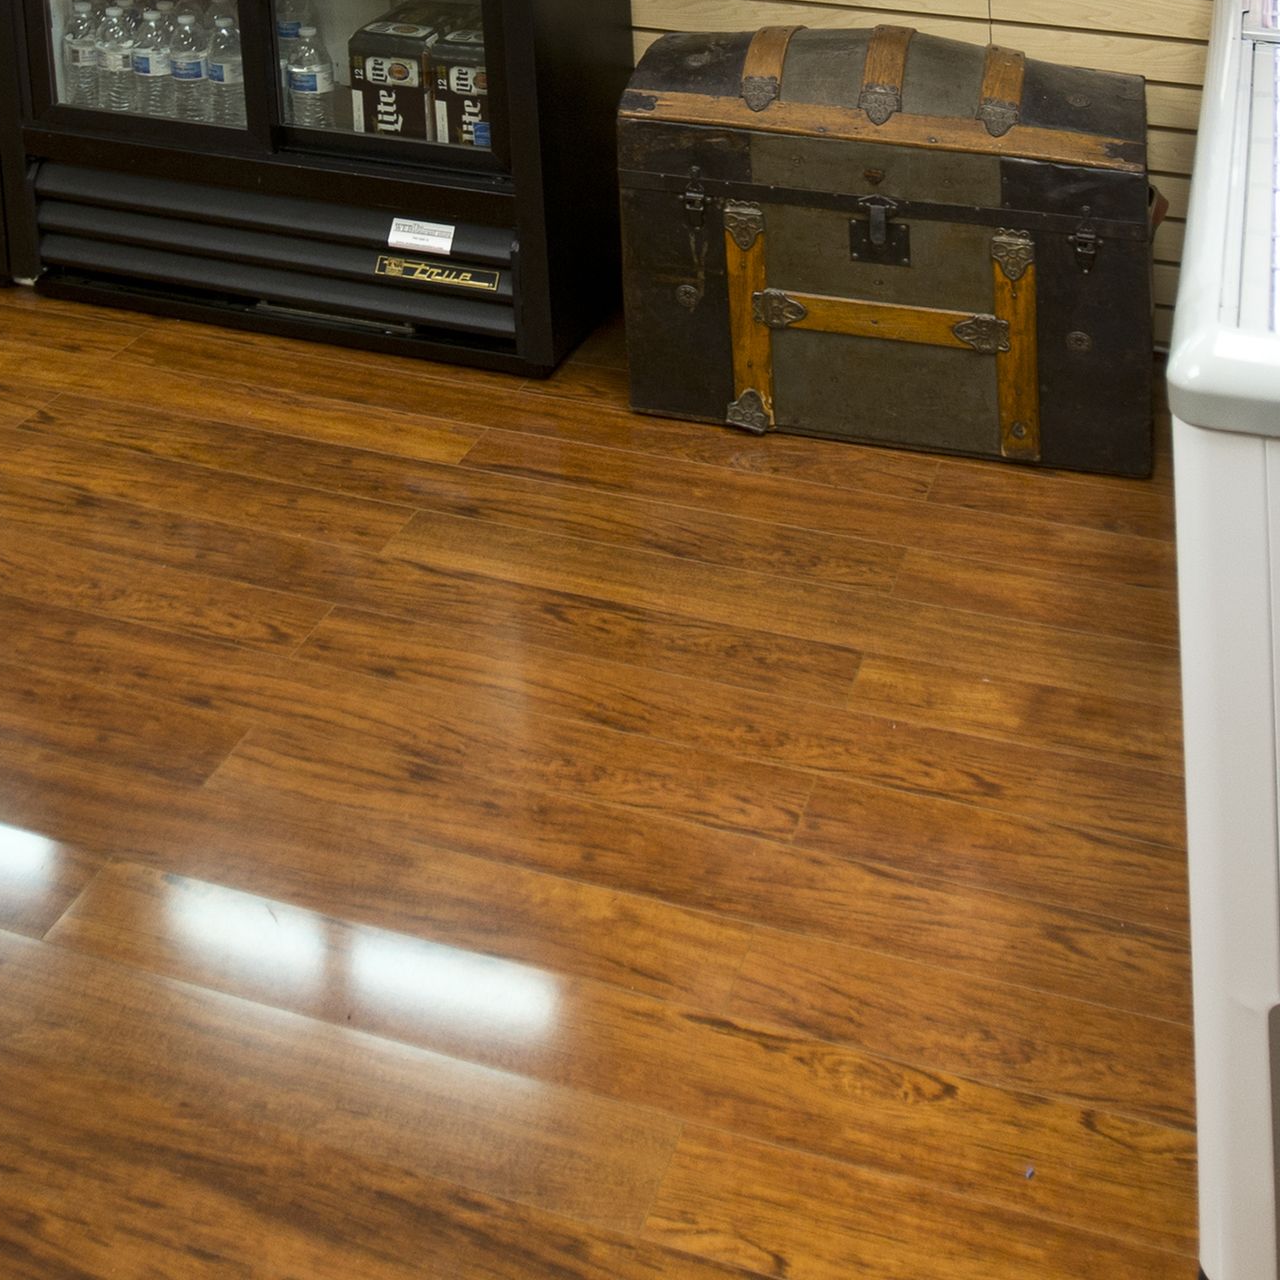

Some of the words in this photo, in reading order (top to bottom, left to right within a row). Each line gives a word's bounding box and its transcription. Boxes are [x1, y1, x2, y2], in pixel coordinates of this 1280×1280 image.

[354, 69, 364, 80] 12
[371, 59, 388, 84] Lite
[456, 69, 473, 93] Lite
[438, 78, 448, 90] 12
[377, 89, 404, 133] Lite
[412, 263, 473, 281] true
